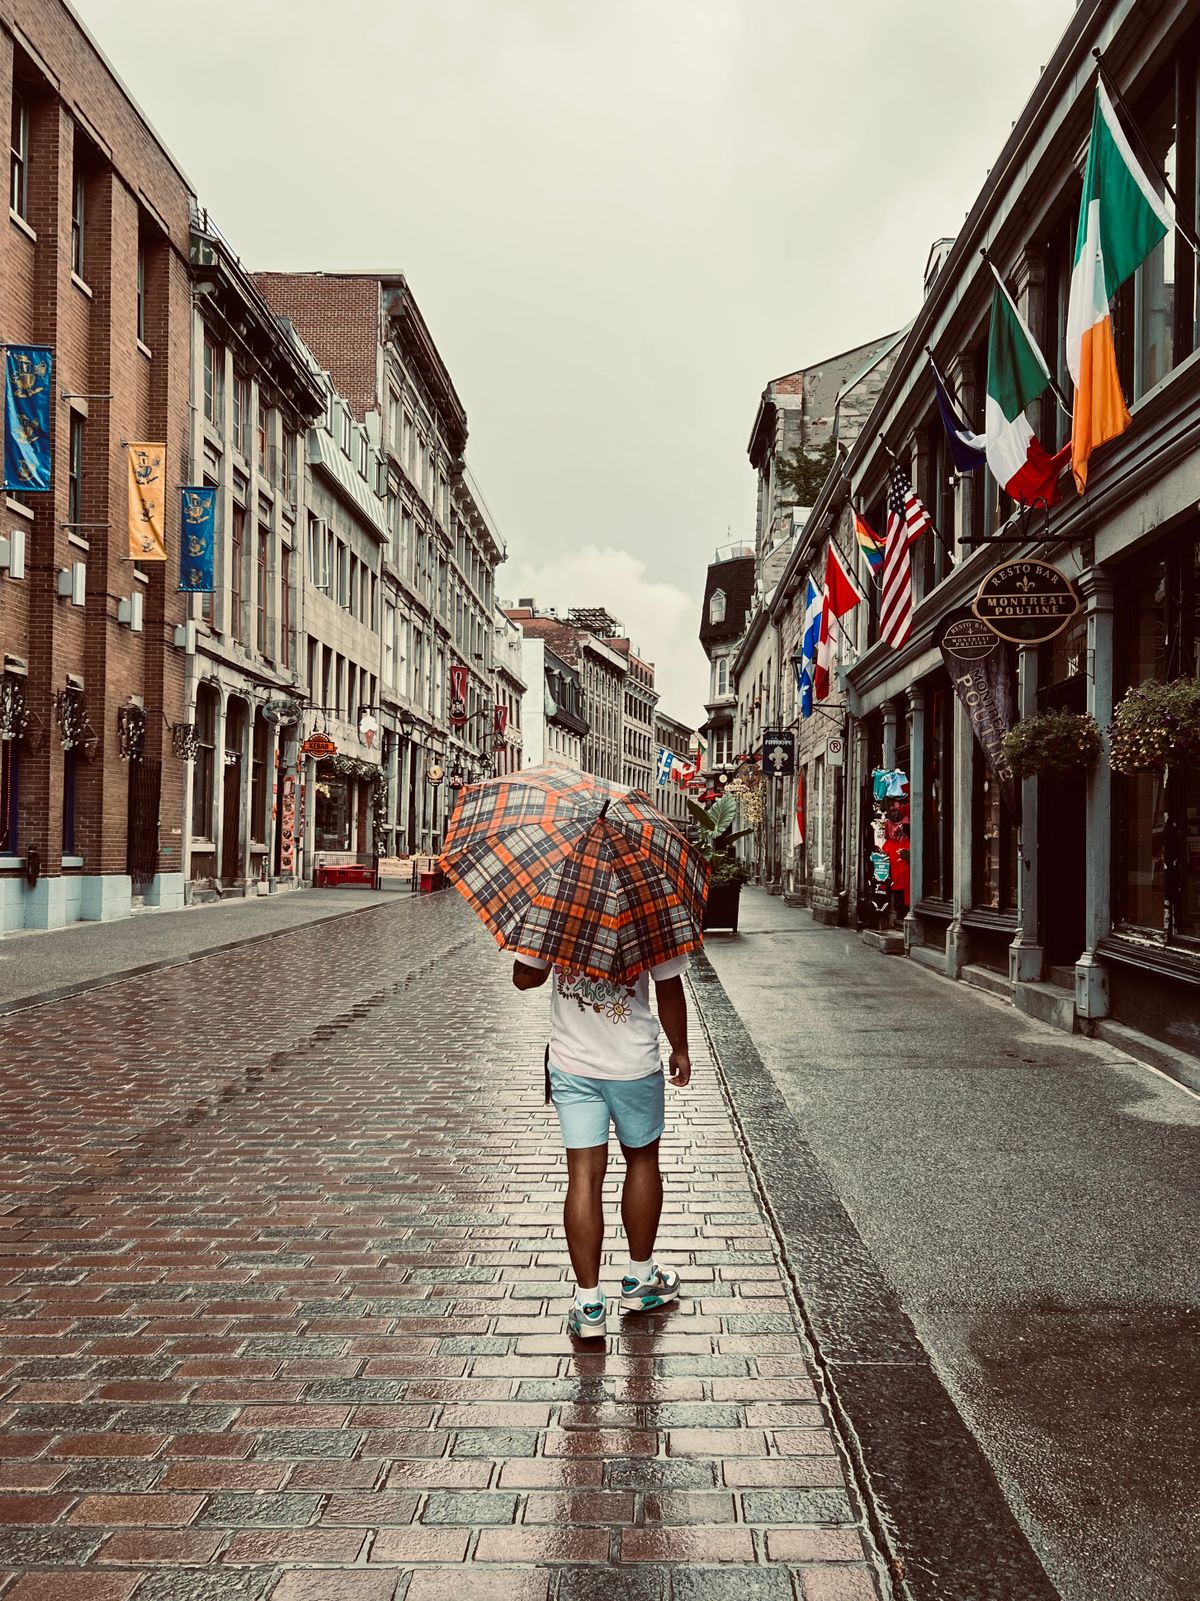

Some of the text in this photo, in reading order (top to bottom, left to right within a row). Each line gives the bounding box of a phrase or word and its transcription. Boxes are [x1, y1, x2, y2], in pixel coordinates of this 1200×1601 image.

[991, 564, 1060, 586] RESTO BAR
[987, 596, 1067, 607] MONTREAL
[995, 606, 1060, 615] POUTINE
[951, 622, 972, 635] RESTO
[971, 668, 1009, 741] MONTREA
[956, 673, 1014, 782] POUTINE
